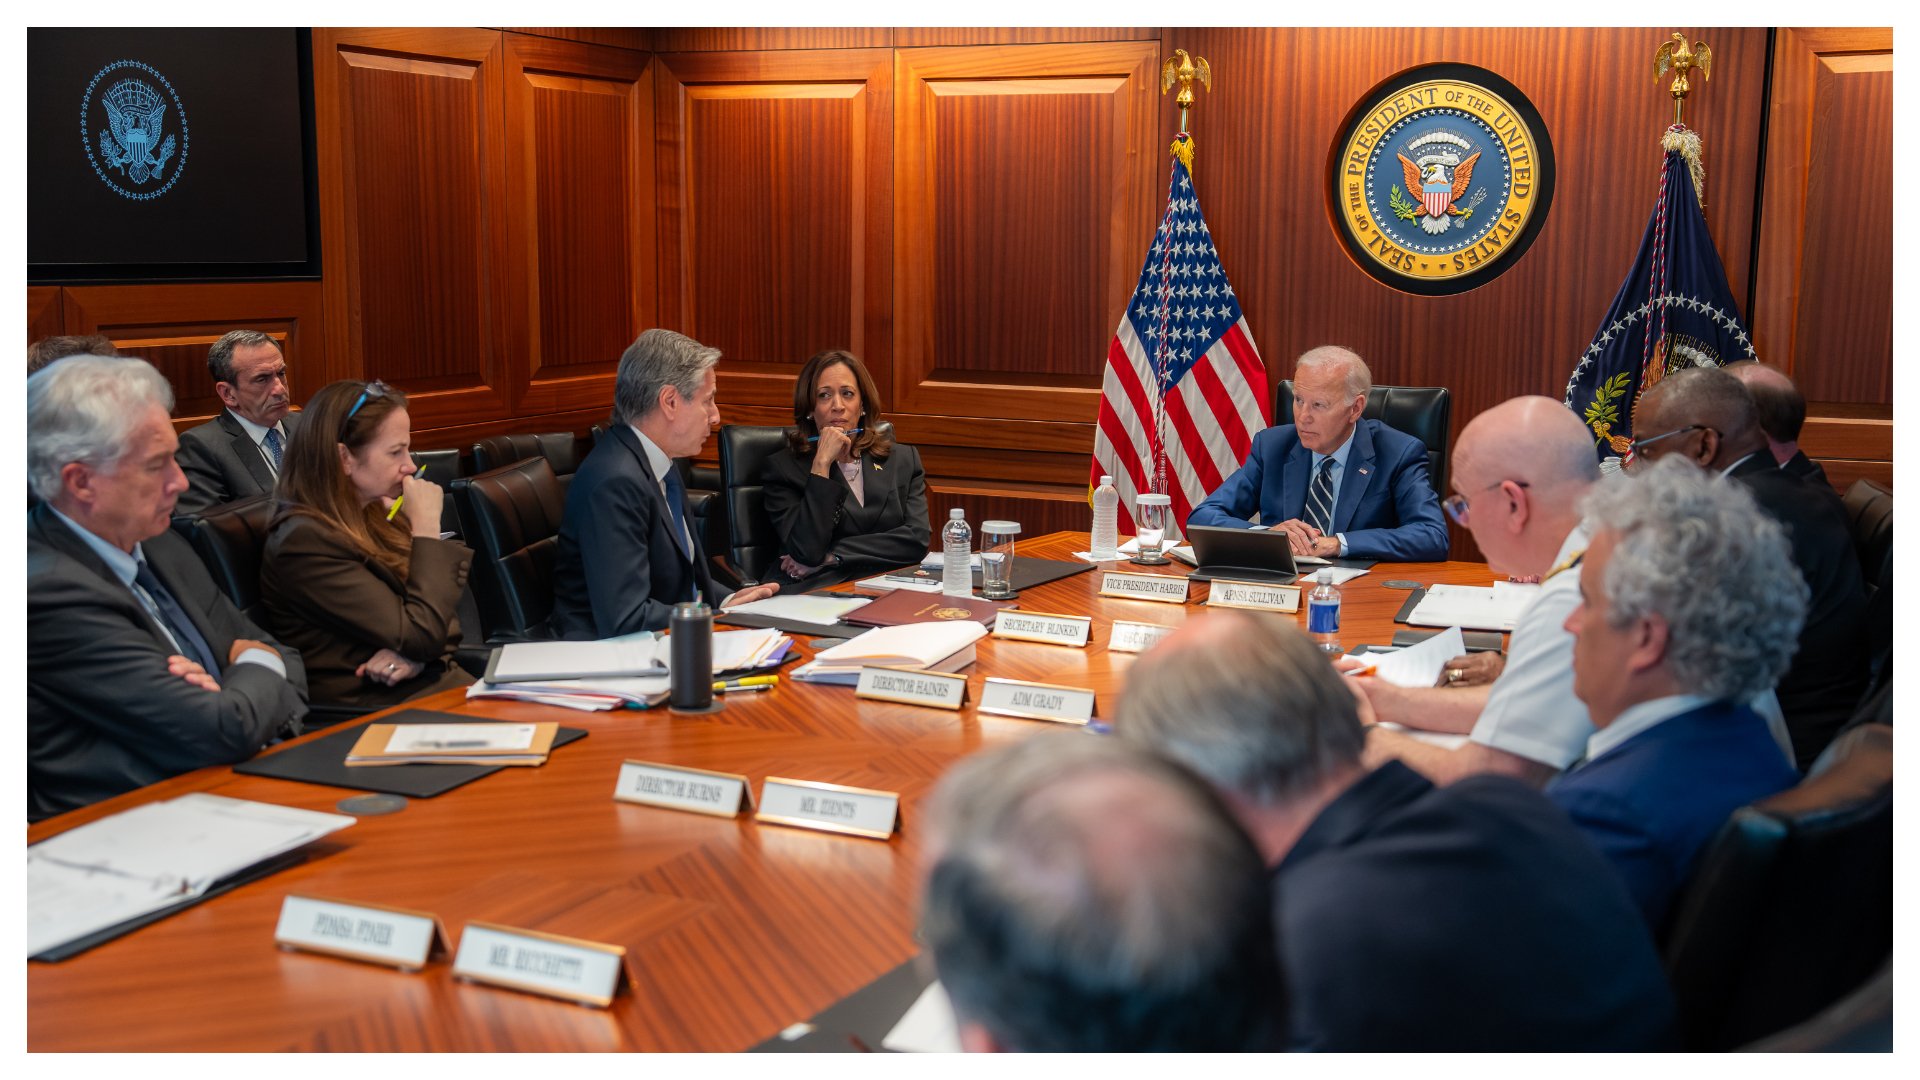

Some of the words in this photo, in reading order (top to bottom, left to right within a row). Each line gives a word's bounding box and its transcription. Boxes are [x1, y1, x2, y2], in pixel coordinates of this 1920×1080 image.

[1445, 90, 1464, 103] OF
[1467, 95, 1494, 116] THE
[1348, 88, 1439, 178] PRESIDENT
[1494, 111, 1531, 199] UNITED
[1349, 182, 1363, 212] THE
[1353, 213, 1369, 232] OF
[1453, 207, 1521, 271] STATES
[1366, 229, 1416, 272] SEAL
[1106, 578, 1122, 590] VICE
[1122, 580, 1160, 593] PRESIDENT
[1159, 582, 1185, 595] HARRIS
[1223, 589, 1247, 602] APNSA
[1248, 591, 1286, 605] SULLIVAN
[1003, 618, 1044, 633] SECRETARY
[1046, 621, 1081, 637] BLINKEN
[872, 675, 915, 694] DIRECTOR
[915, 680, 950, 697] HAINES
[1011, 692, 1032, 706] ADM
[1034, 693, 1065, 711] GRADY
[637, 774, 685, 797] DIRECTOR
